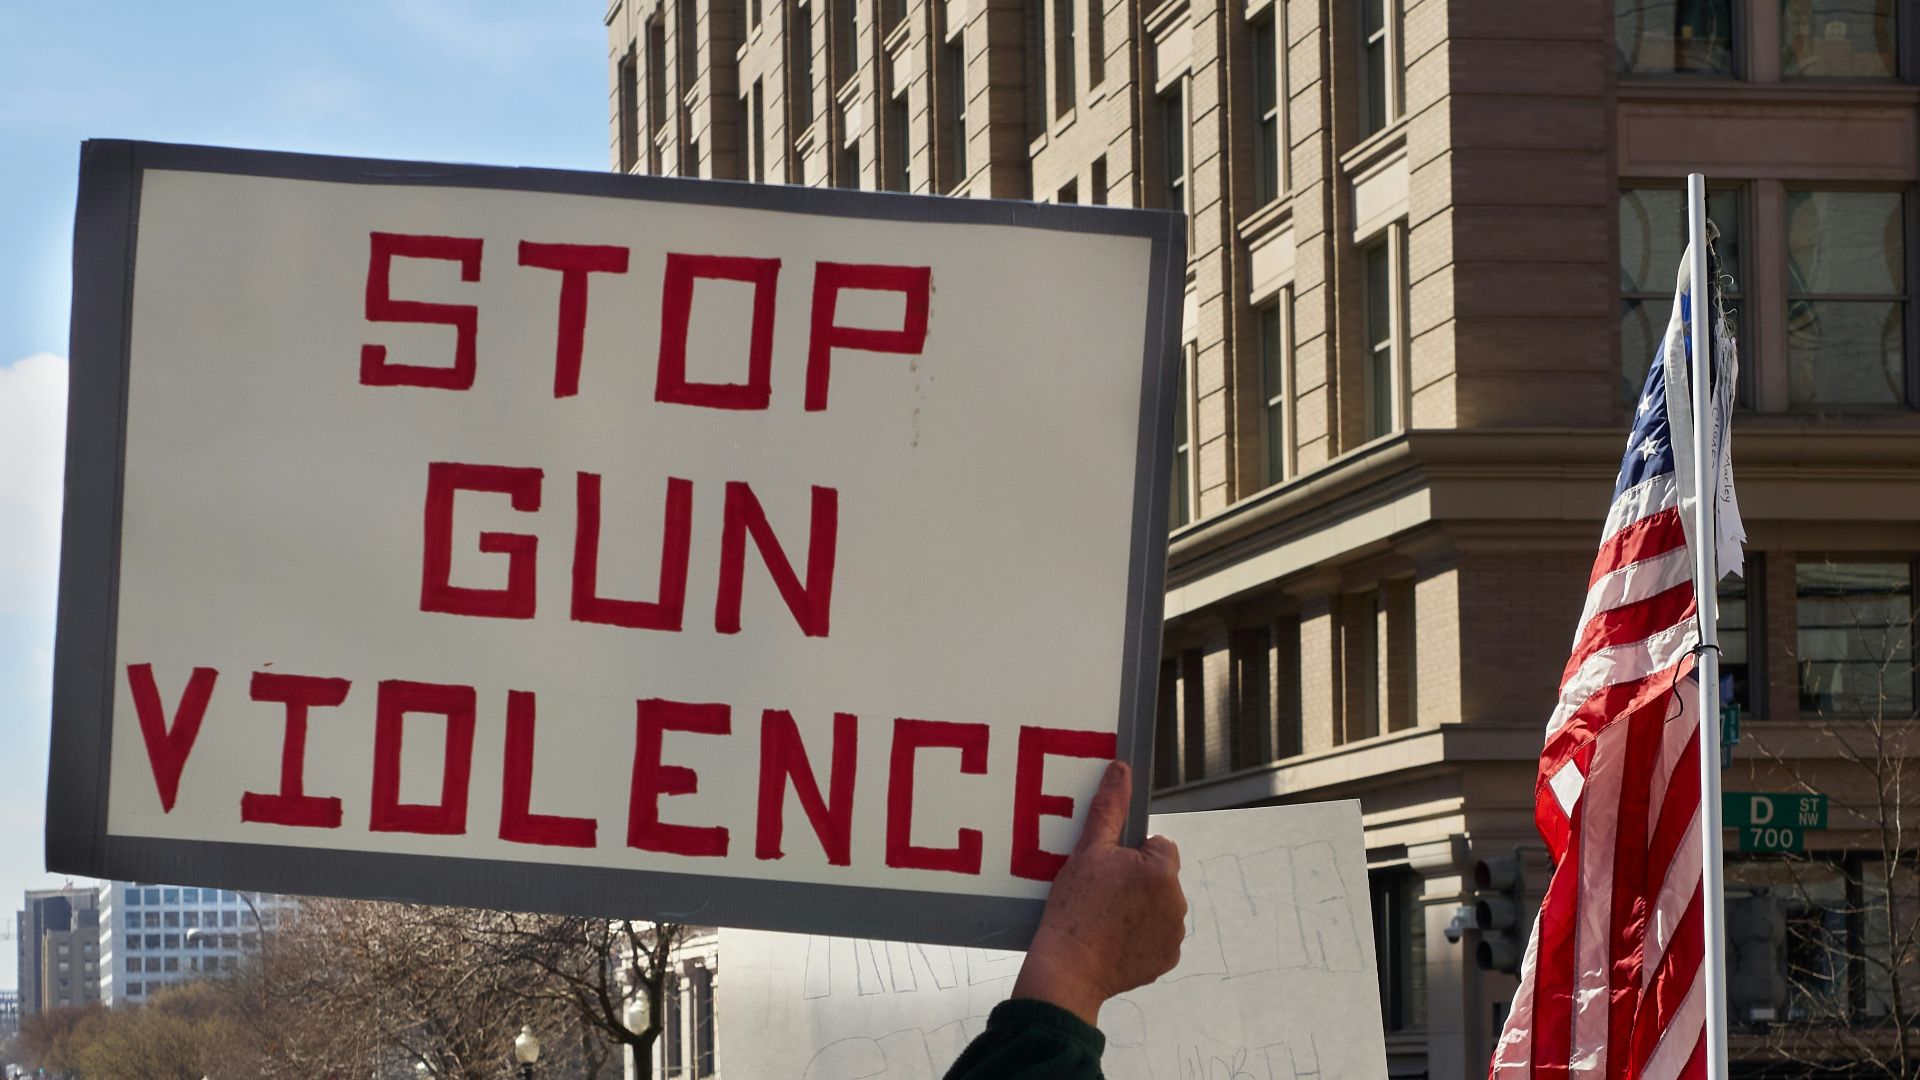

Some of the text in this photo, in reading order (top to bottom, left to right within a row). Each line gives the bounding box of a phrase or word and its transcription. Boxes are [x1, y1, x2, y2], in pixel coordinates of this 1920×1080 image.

[360, 233, 931, 412] STOP
[1720, 452, 1732, 503] Marley
[420, 463, 838, 637] GUN
[127, 664, 1118, 882] VIOLENCE
[1751, 796, 1819, 824] D ST
[1799, 813, 1818, 826] NW
[1750, 828, 1793, 848] 700
